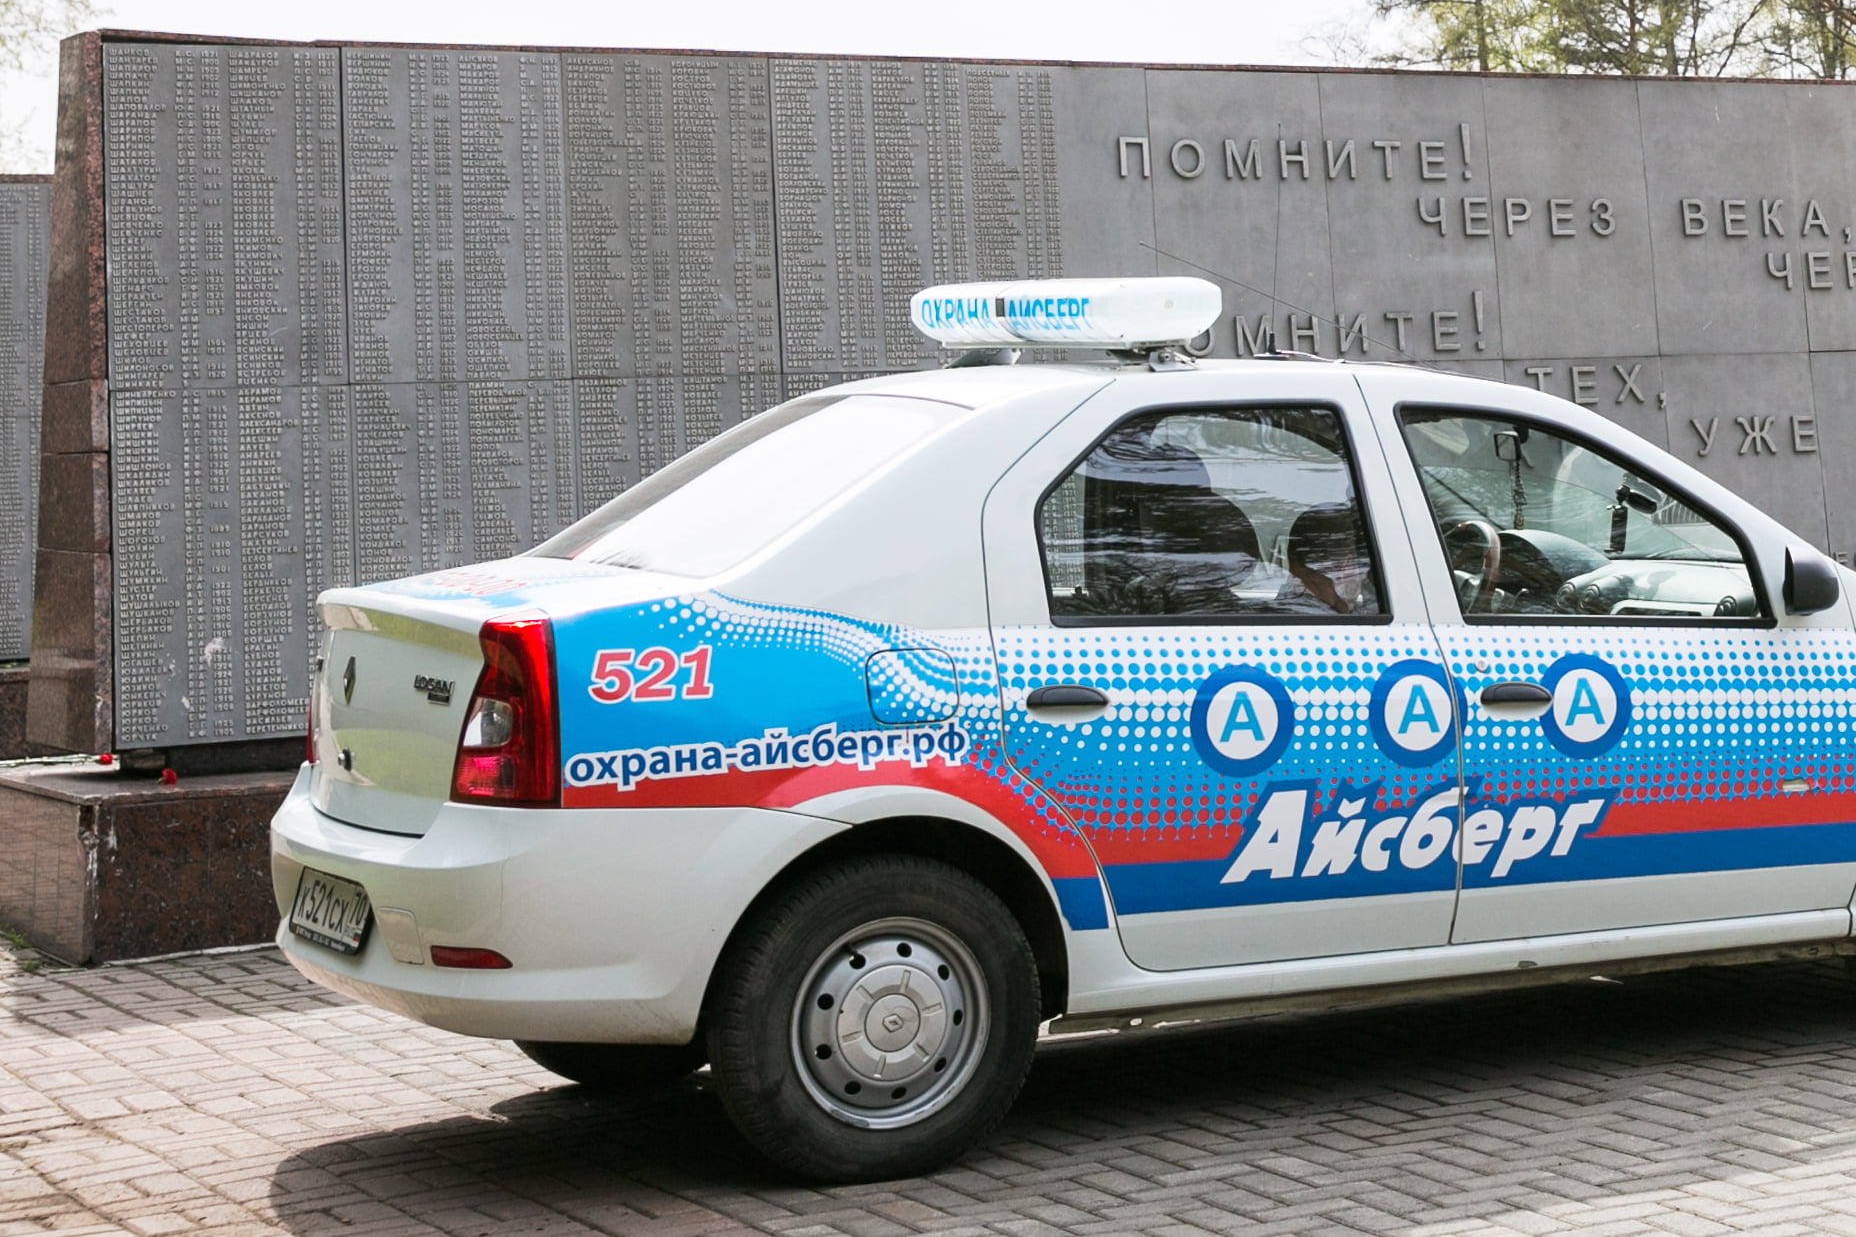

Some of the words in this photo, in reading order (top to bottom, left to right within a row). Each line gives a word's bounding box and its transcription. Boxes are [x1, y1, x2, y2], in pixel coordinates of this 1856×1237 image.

[1117, 123, 1472, 180] ПОМНИТЕ!
[1418, 197, 1616, 237] ЧЕРЕЗ
[1681, 198, 1853, 244] ВЕКА,
[921, 298, 998, 329] ОХРАНА
[1526, 363, 1668, 410] ТЕХ,
[1691, 415, 1818, 457] УЖЕ
[414, 674, 454, 693] LOGAN
[590, 646, 713, 703] 521
[567, 722, 967, 790] охрана-айсберг.рф
[1220, 786, 1606, 884] Айсберг
